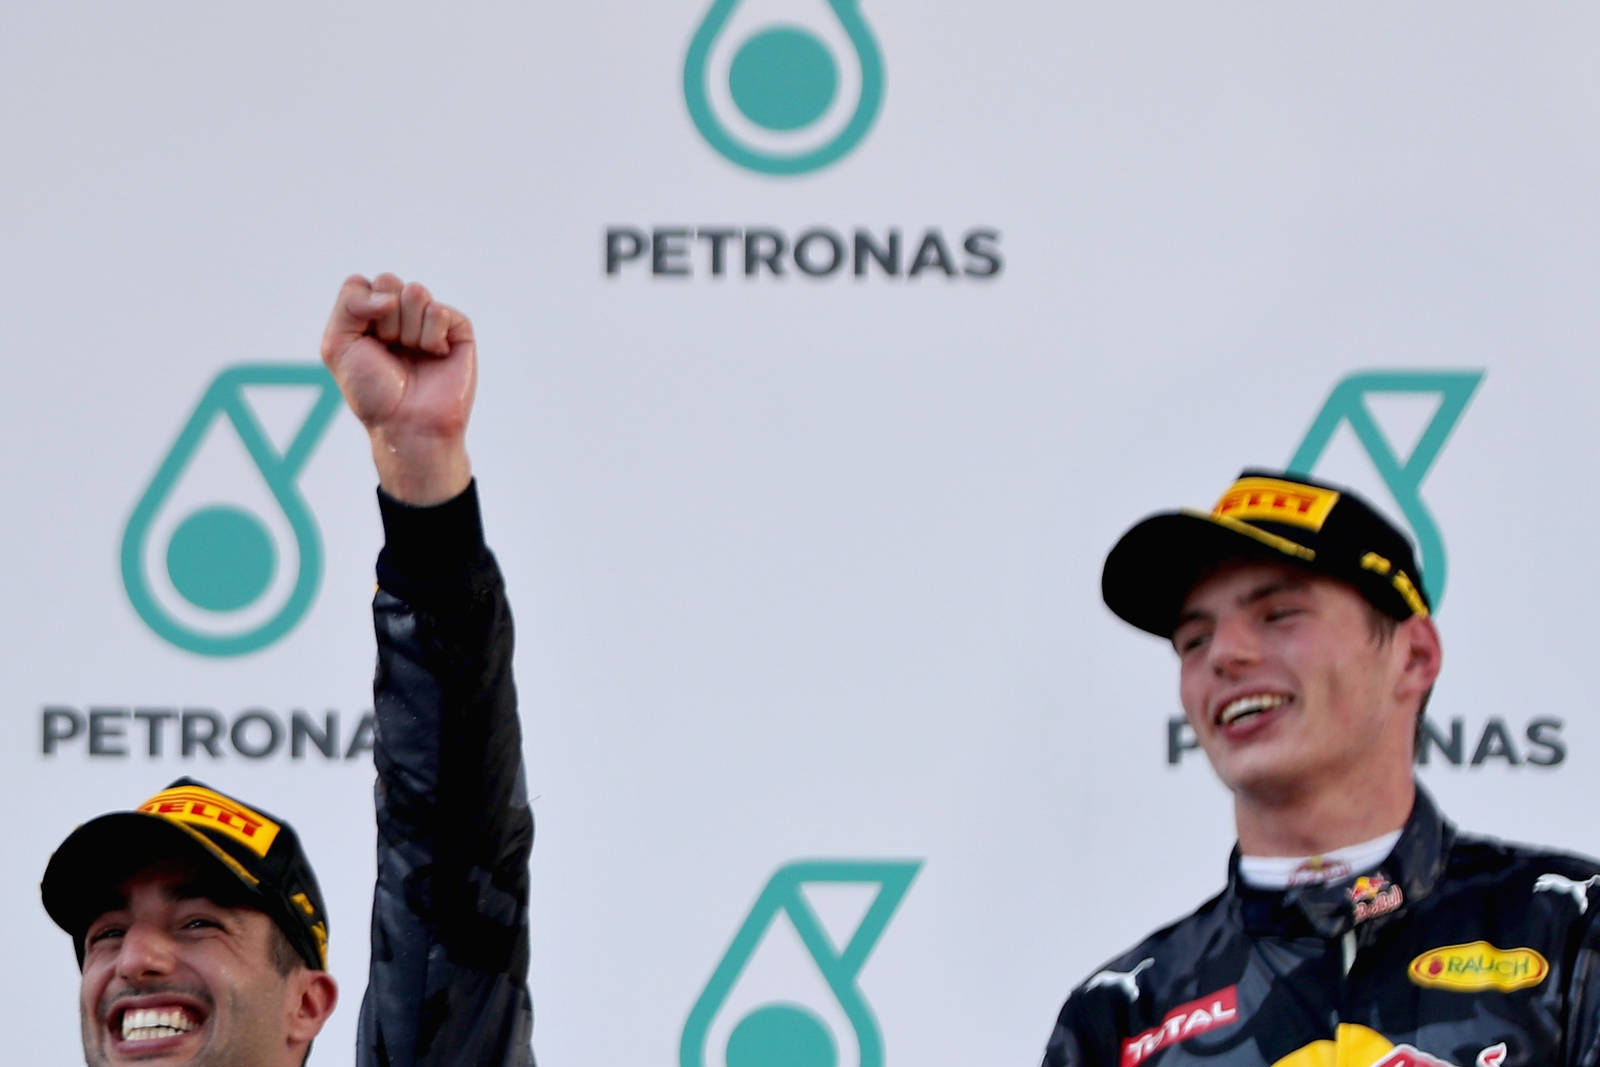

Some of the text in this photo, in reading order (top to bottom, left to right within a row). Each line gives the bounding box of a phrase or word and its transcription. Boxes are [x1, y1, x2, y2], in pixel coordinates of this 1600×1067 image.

[604, 225, 1003, 279] PETRONAS
[42, 706, 376, 758] PETRONA
[1166, 718, 1566, 767] PNAS
